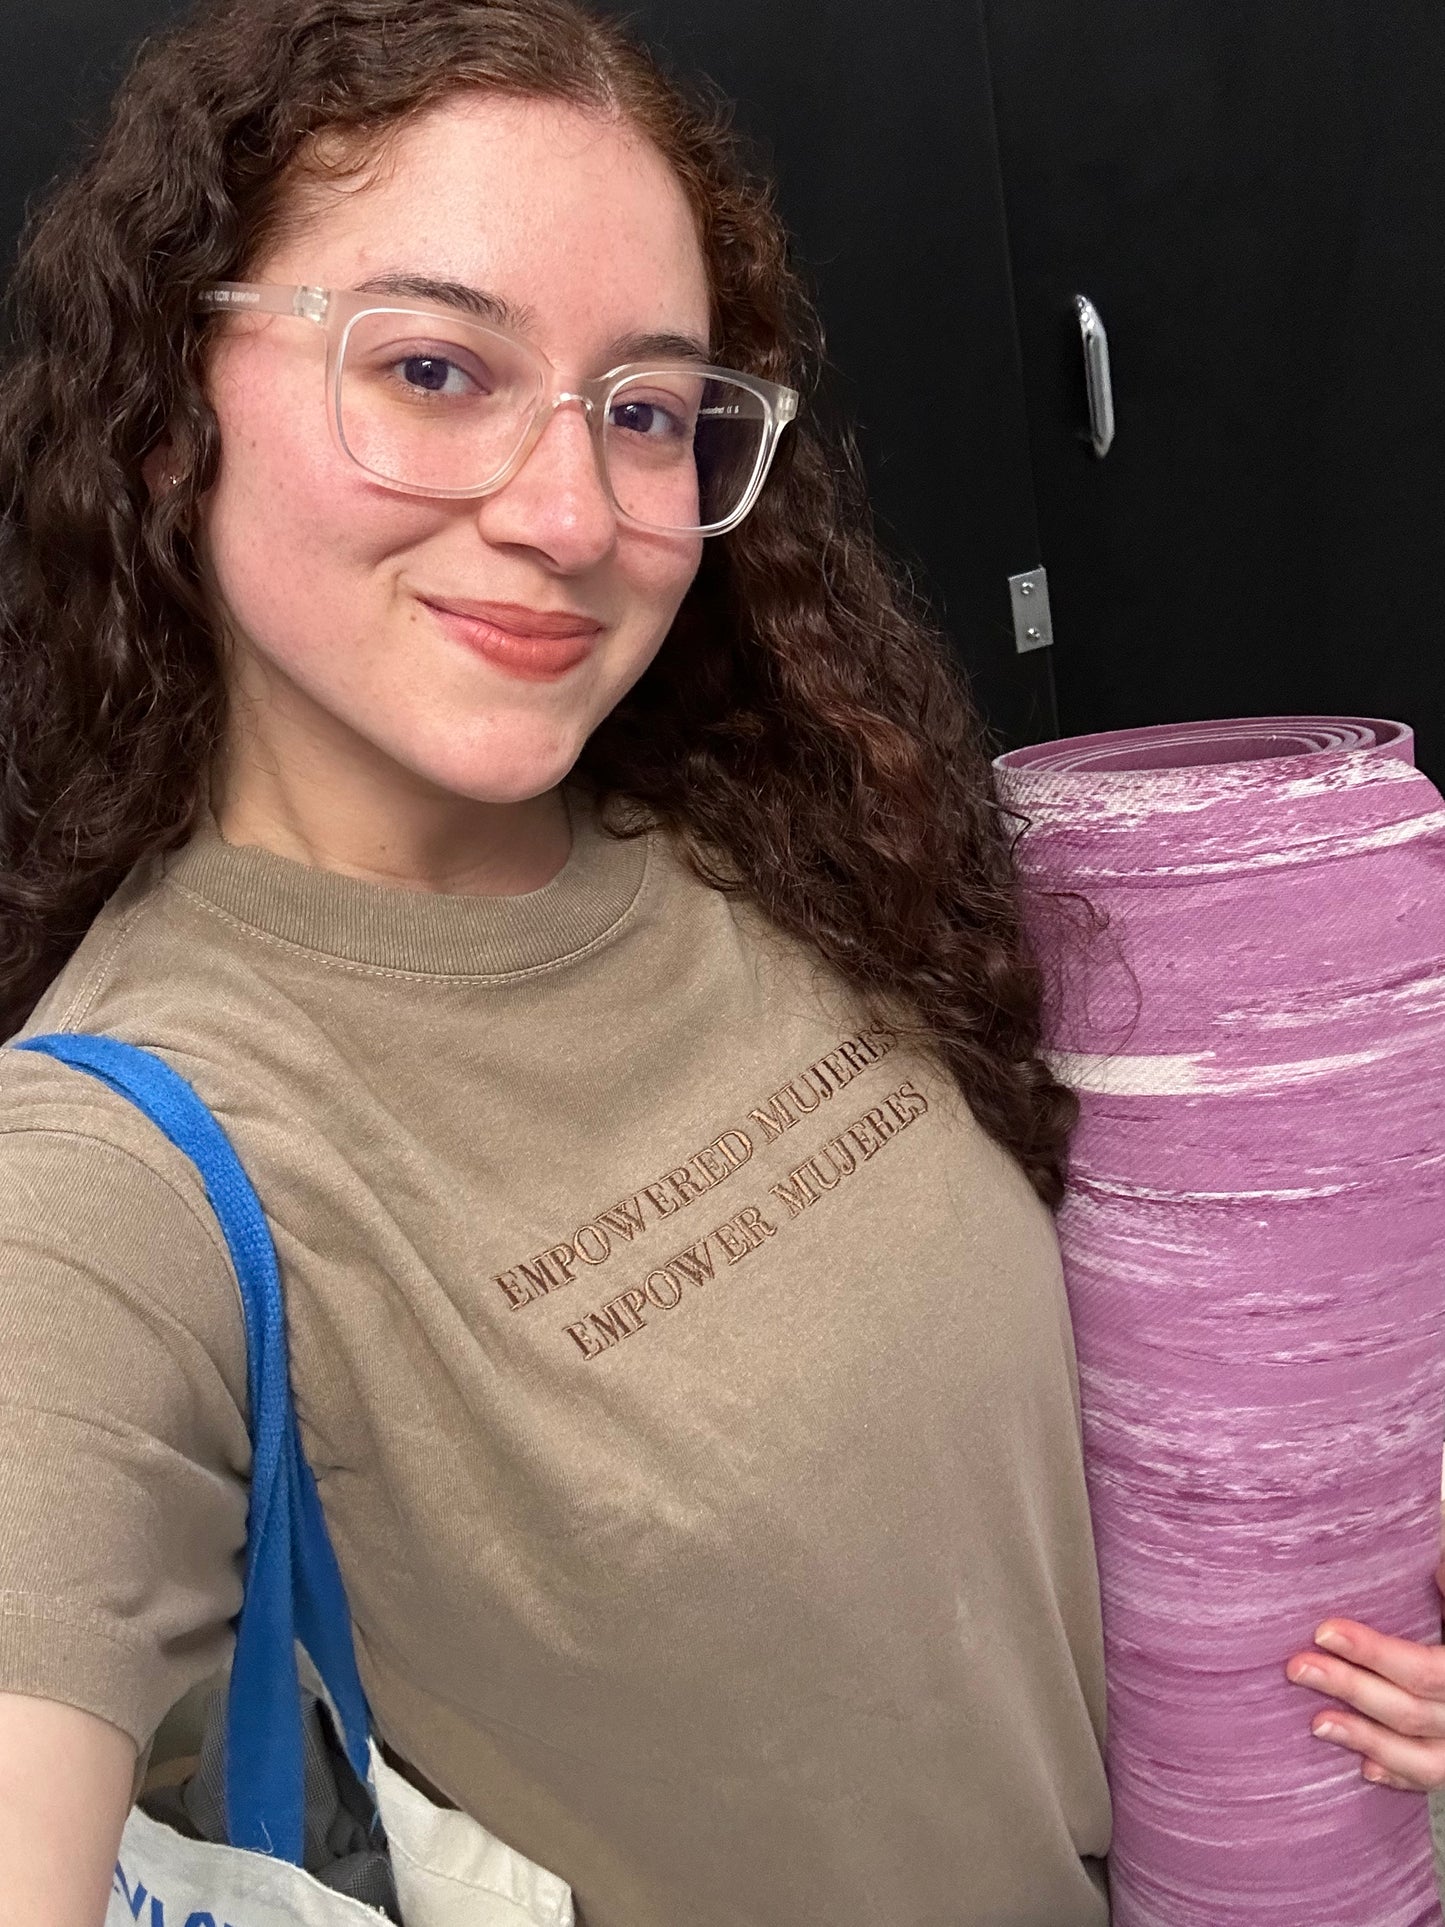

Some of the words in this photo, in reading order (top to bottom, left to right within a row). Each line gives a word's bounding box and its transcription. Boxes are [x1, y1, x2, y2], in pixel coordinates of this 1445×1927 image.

[493, 1128, 754, 1311] EMPOWERED
[747, 1020, 898, 1145] MUJERES
[562, 1205, 777, 1361] EMPOWER
[768, 1081, 929, 1220] MUJERES
